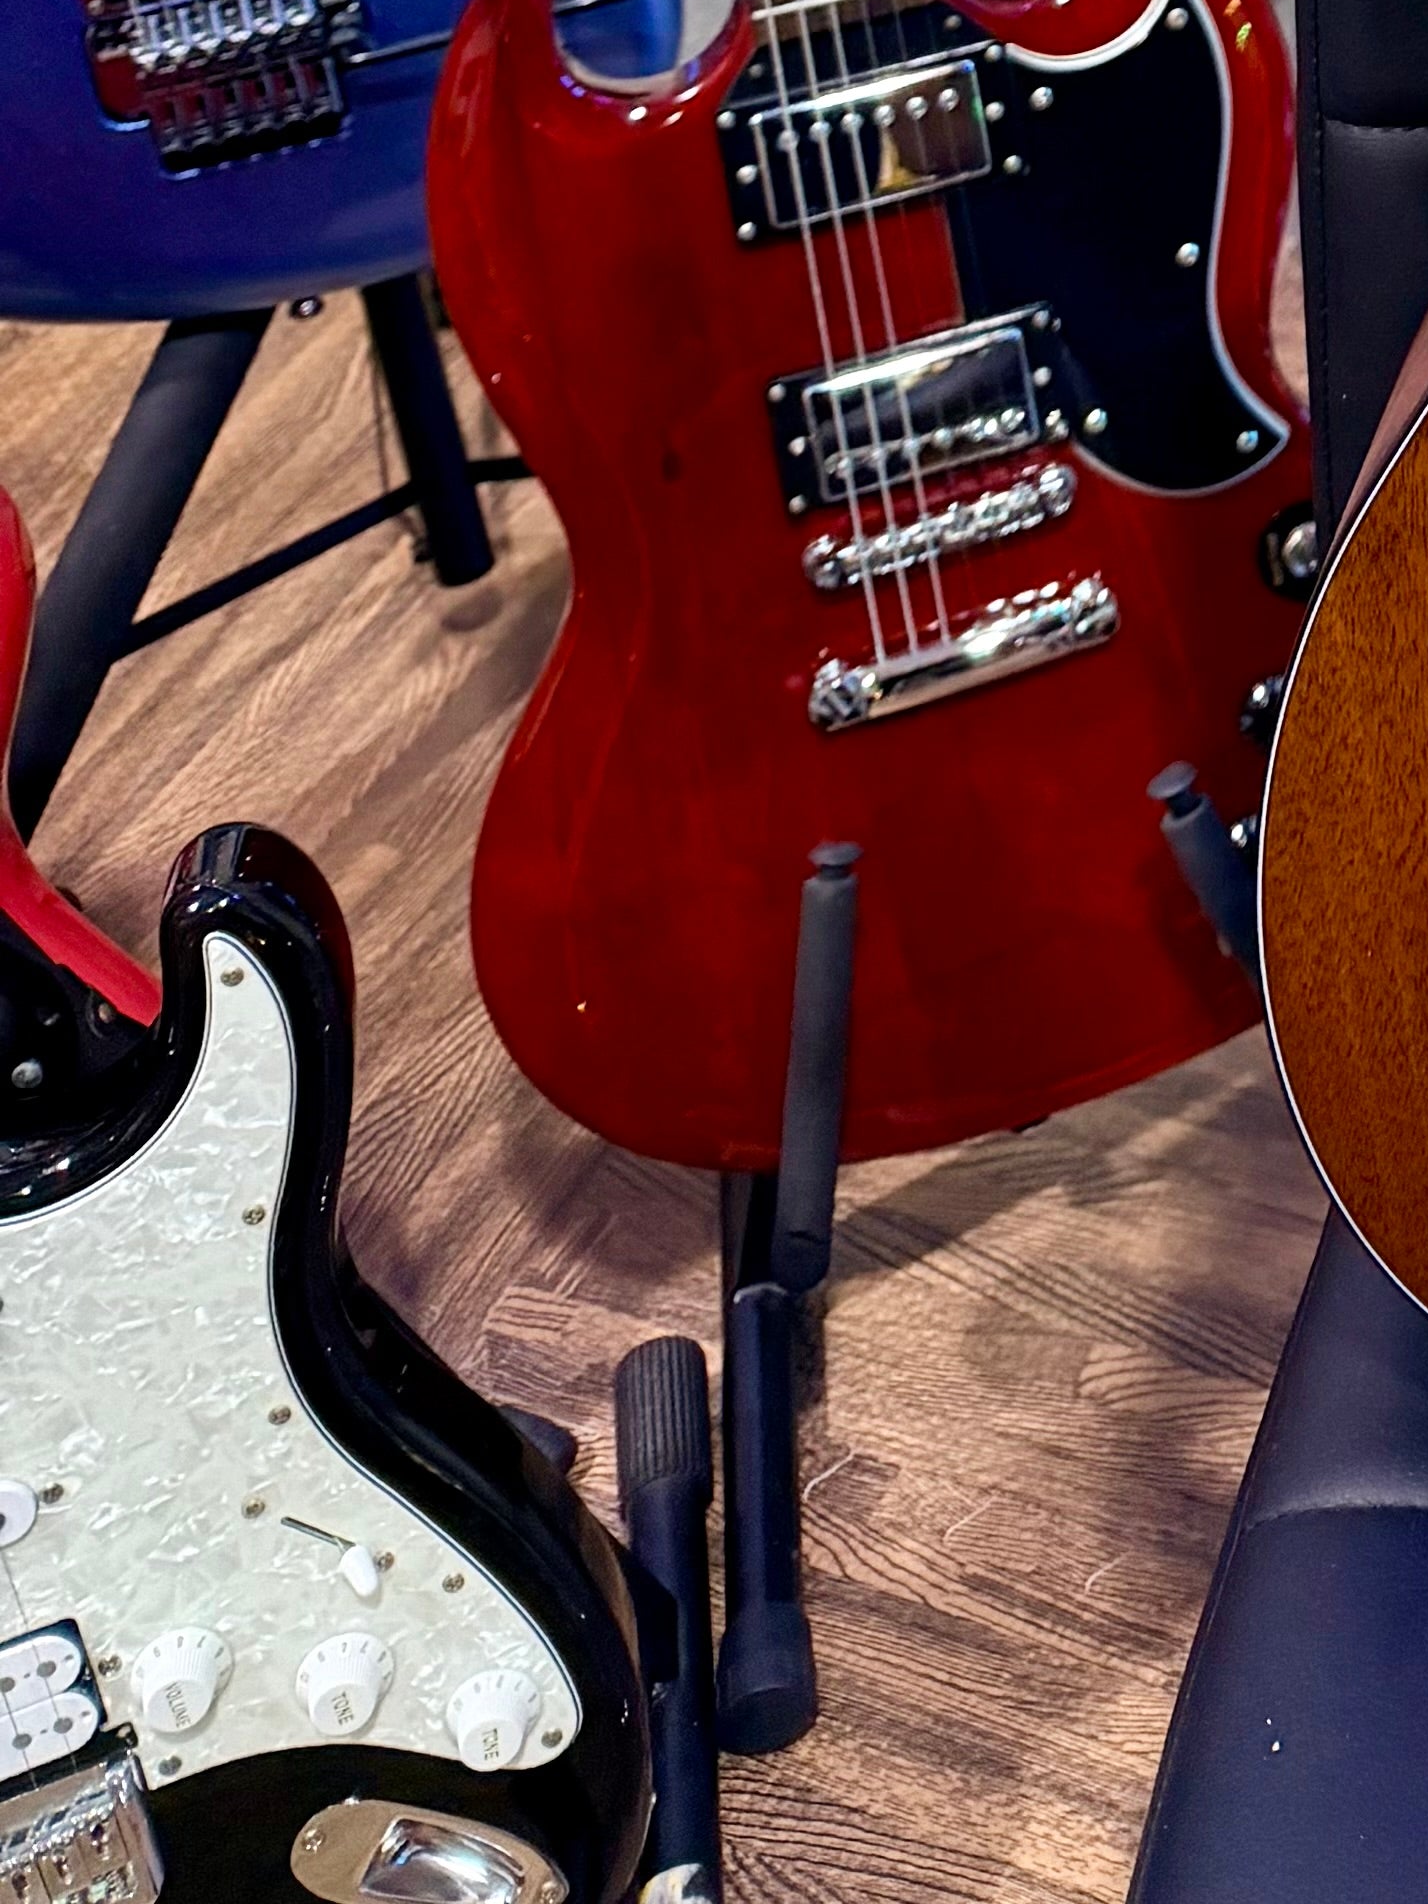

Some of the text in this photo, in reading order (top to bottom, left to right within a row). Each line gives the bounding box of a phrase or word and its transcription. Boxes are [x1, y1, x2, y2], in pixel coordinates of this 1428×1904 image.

[165, 1681, 192, 1729] VOLUME
[331, 1691, 354, 1726] TONE
[482, 1727, 499, 1761] TONE
